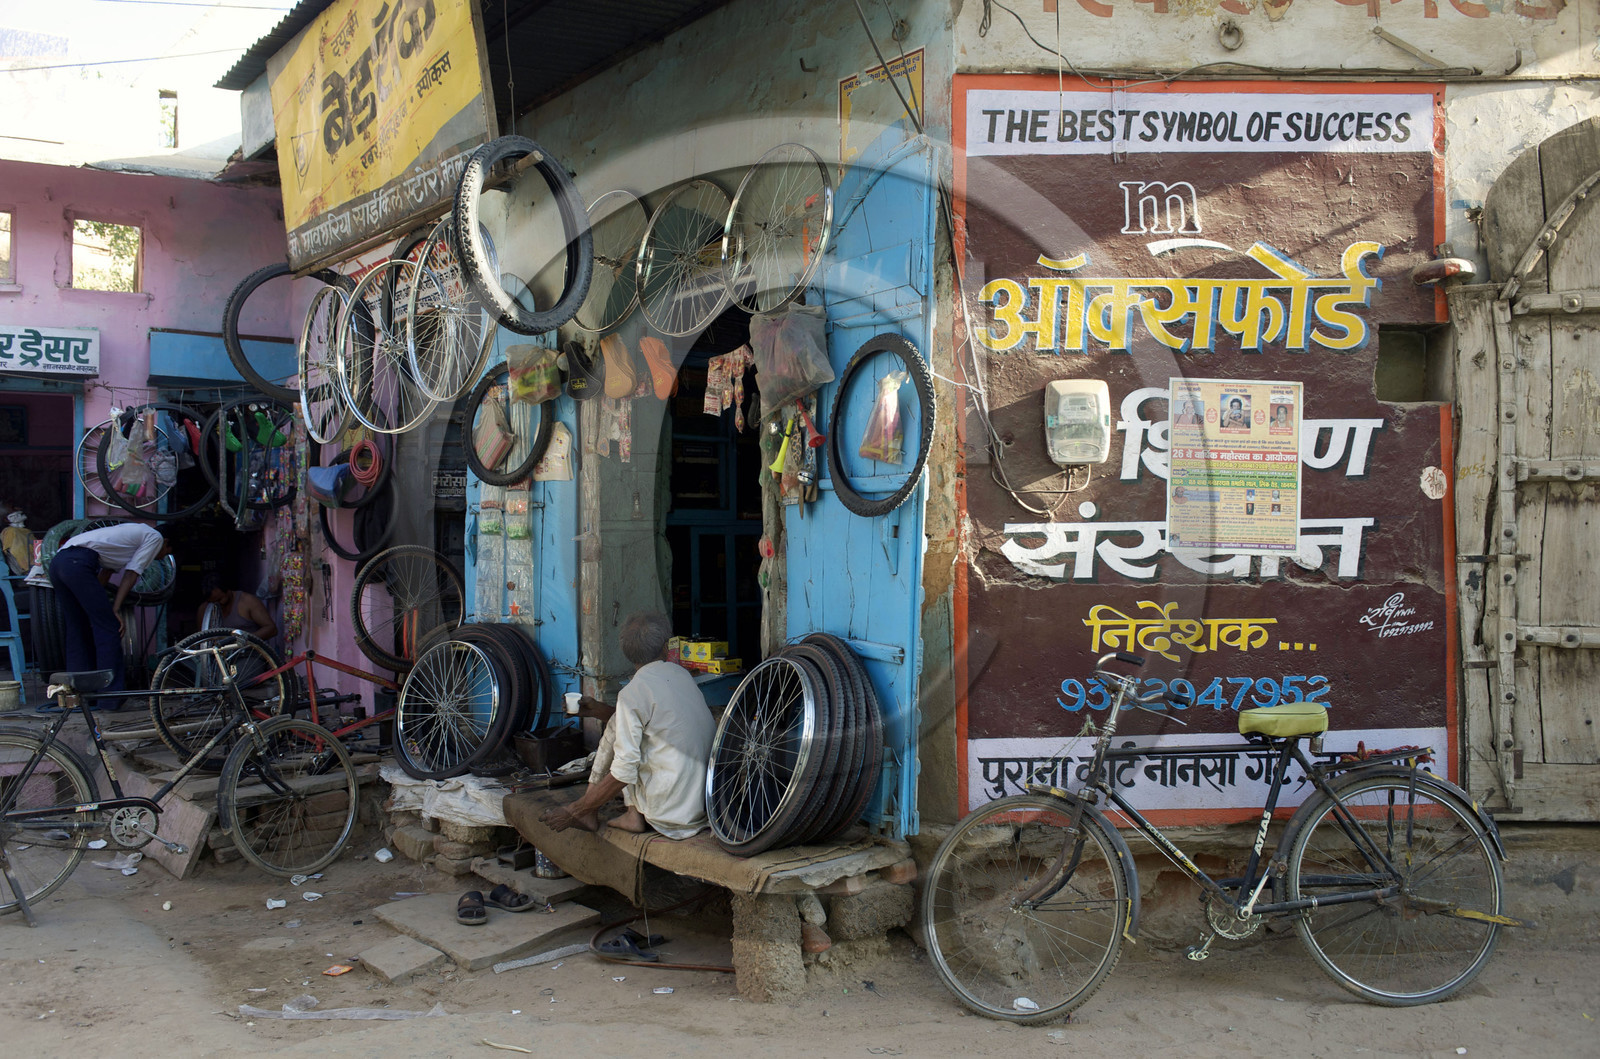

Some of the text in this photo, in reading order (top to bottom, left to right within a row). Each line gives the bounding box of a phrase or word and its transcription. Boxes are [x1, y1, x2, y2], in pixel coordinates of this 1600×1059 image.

[982, 109, 1413, 144] THE BEST SYMBOL OF SUCCESS
[975, 239, 1386, 354] ऑक्सफोर्ड
[18, 328, 92, 368] ड्रेसर
[1172, 448, 1184, 459] 26
[1252, 452, 1263, 462] का
[1264, 452, 1297, 463] आयोजन
[1056, 675, 1332, 712] 932947952
[978, 755, 1074, 800] पुराना
[1143, 753, 1240, 793] नानसा
[1253, 811, 1272, 857] ATLAS
